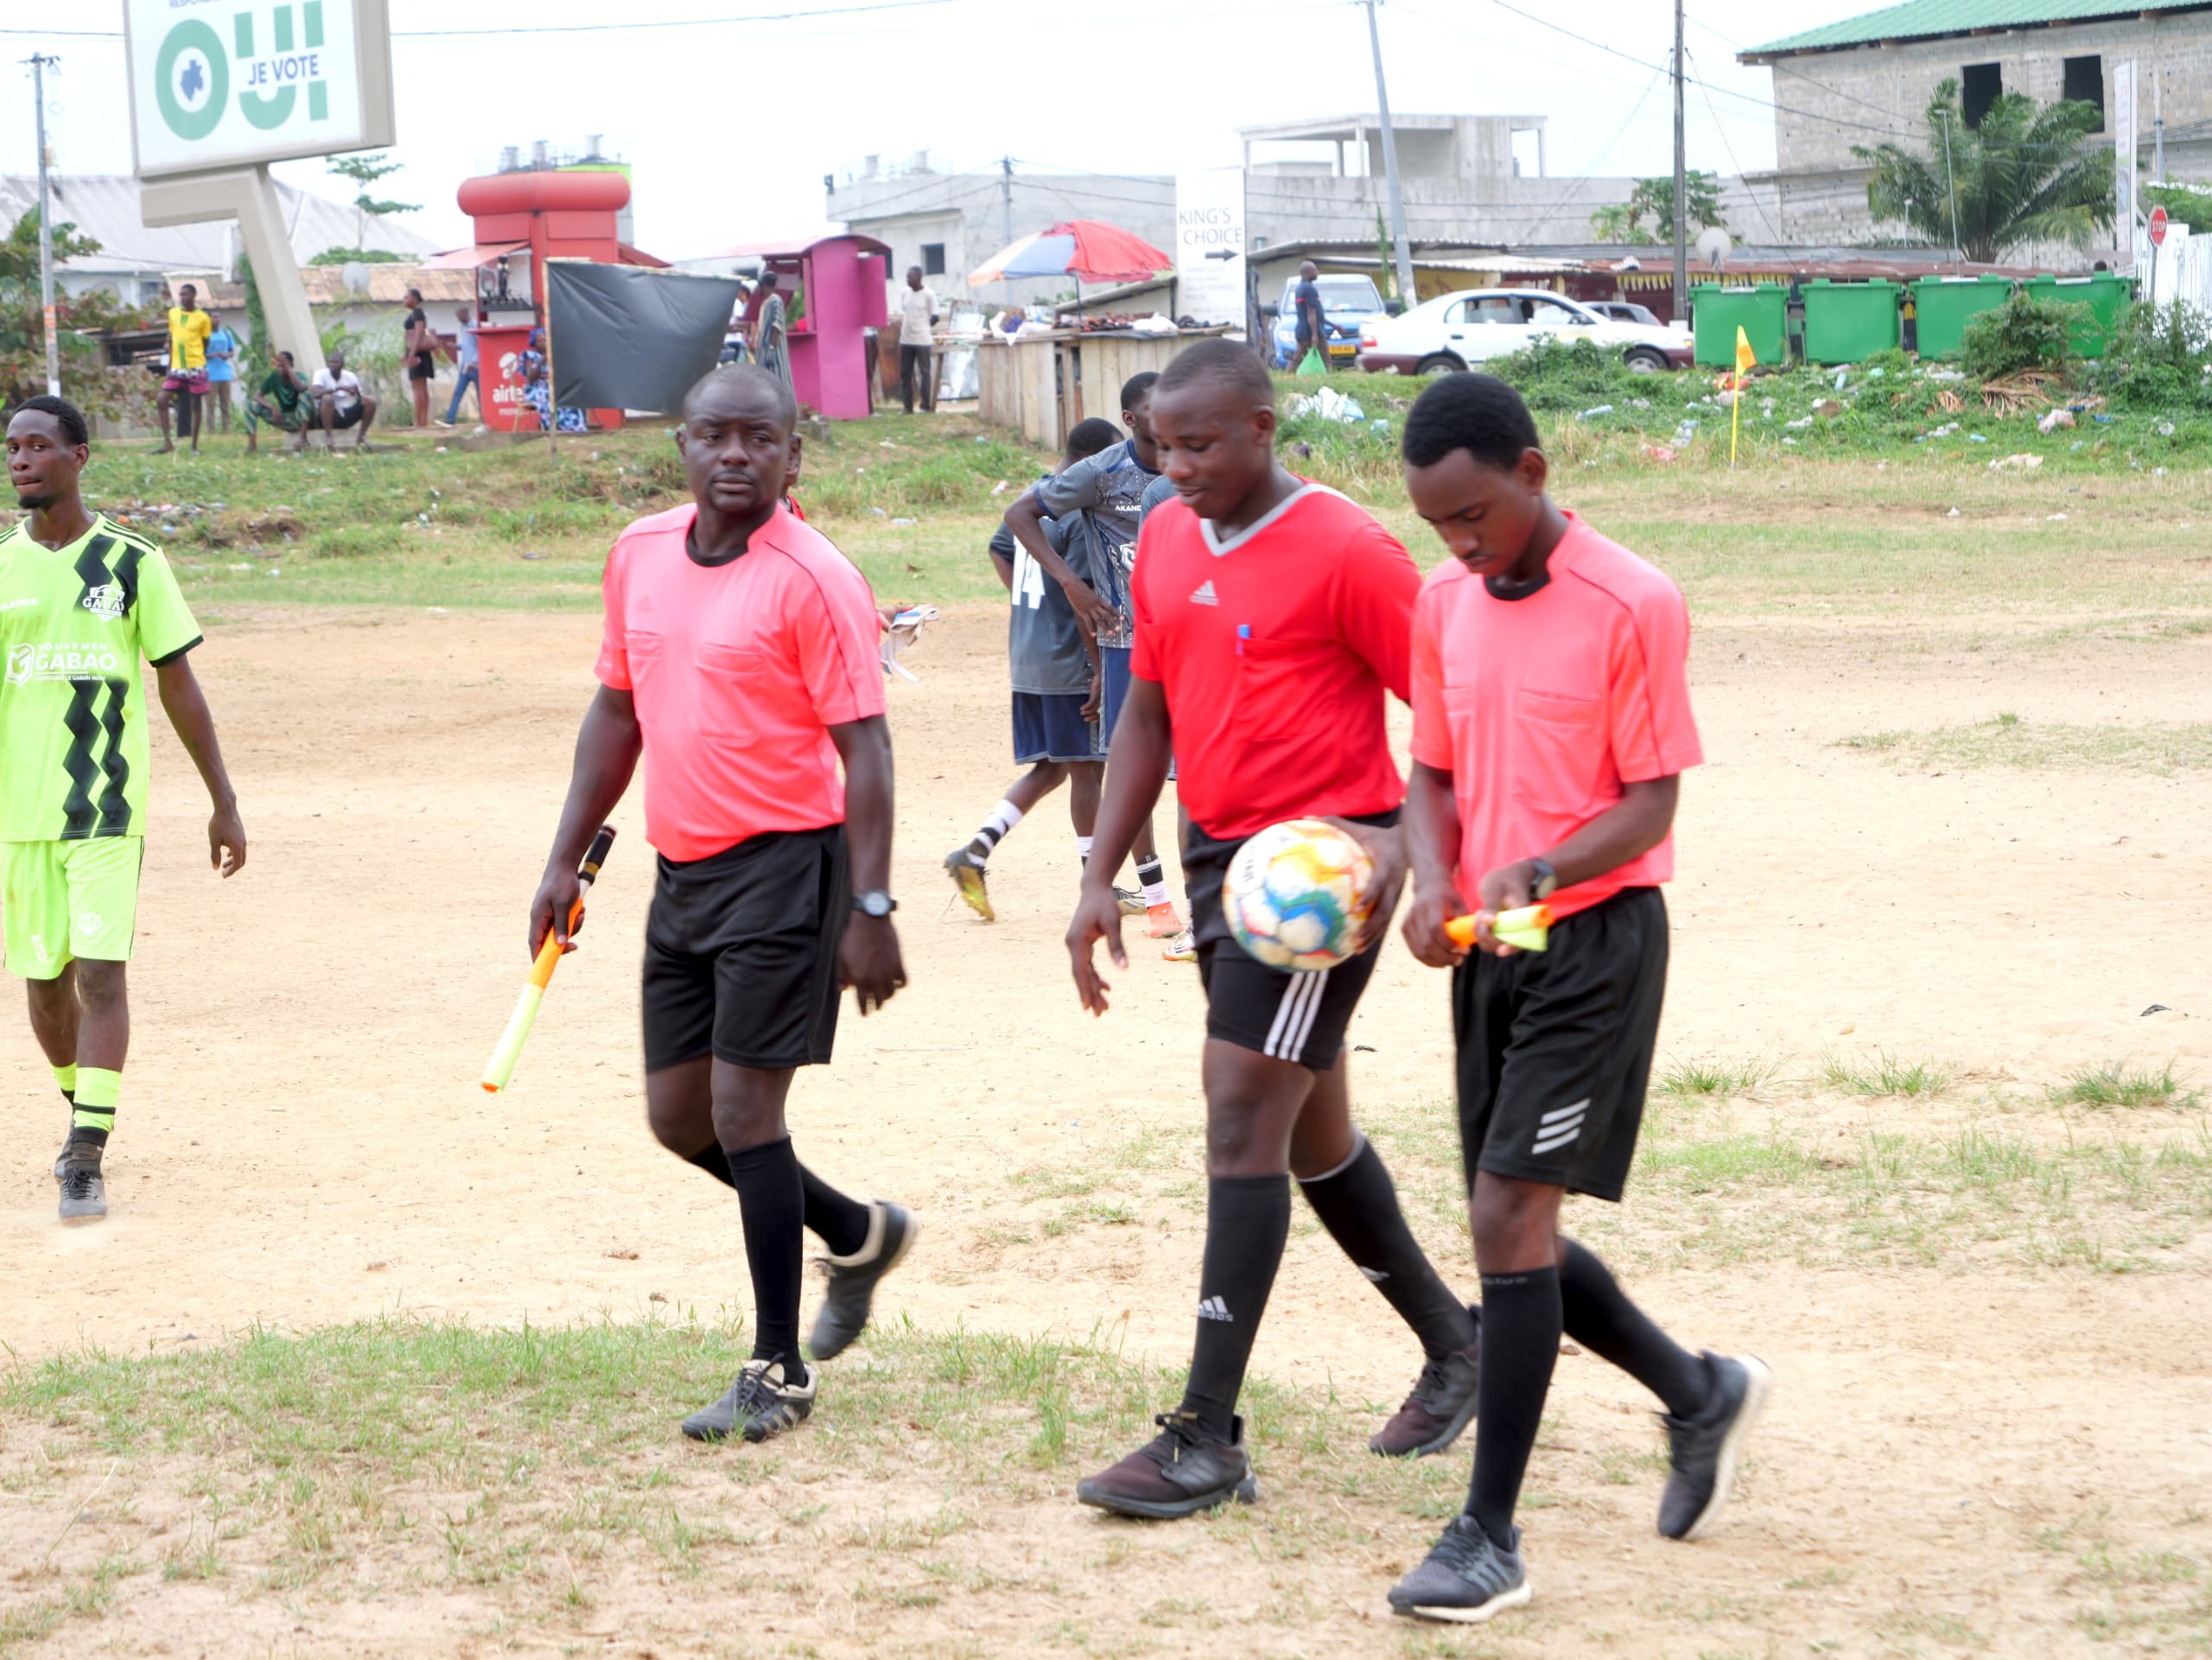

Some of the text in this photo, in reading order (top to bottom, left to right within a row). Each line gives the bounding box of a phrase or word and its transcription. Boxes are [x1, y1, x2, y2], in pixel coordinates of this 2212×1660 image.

[155, 0, 329, 141] OUI
[248, 54, 319, 86] JE VOTE
[1179, 207, 1231, 225] KING'S
[2152, 220, 2166, 232] STOP
[1183, 227, 1243, 245] CHOICE
[492, 384, 524, 403] airte
[35, 652, 118, 671] GABAO
